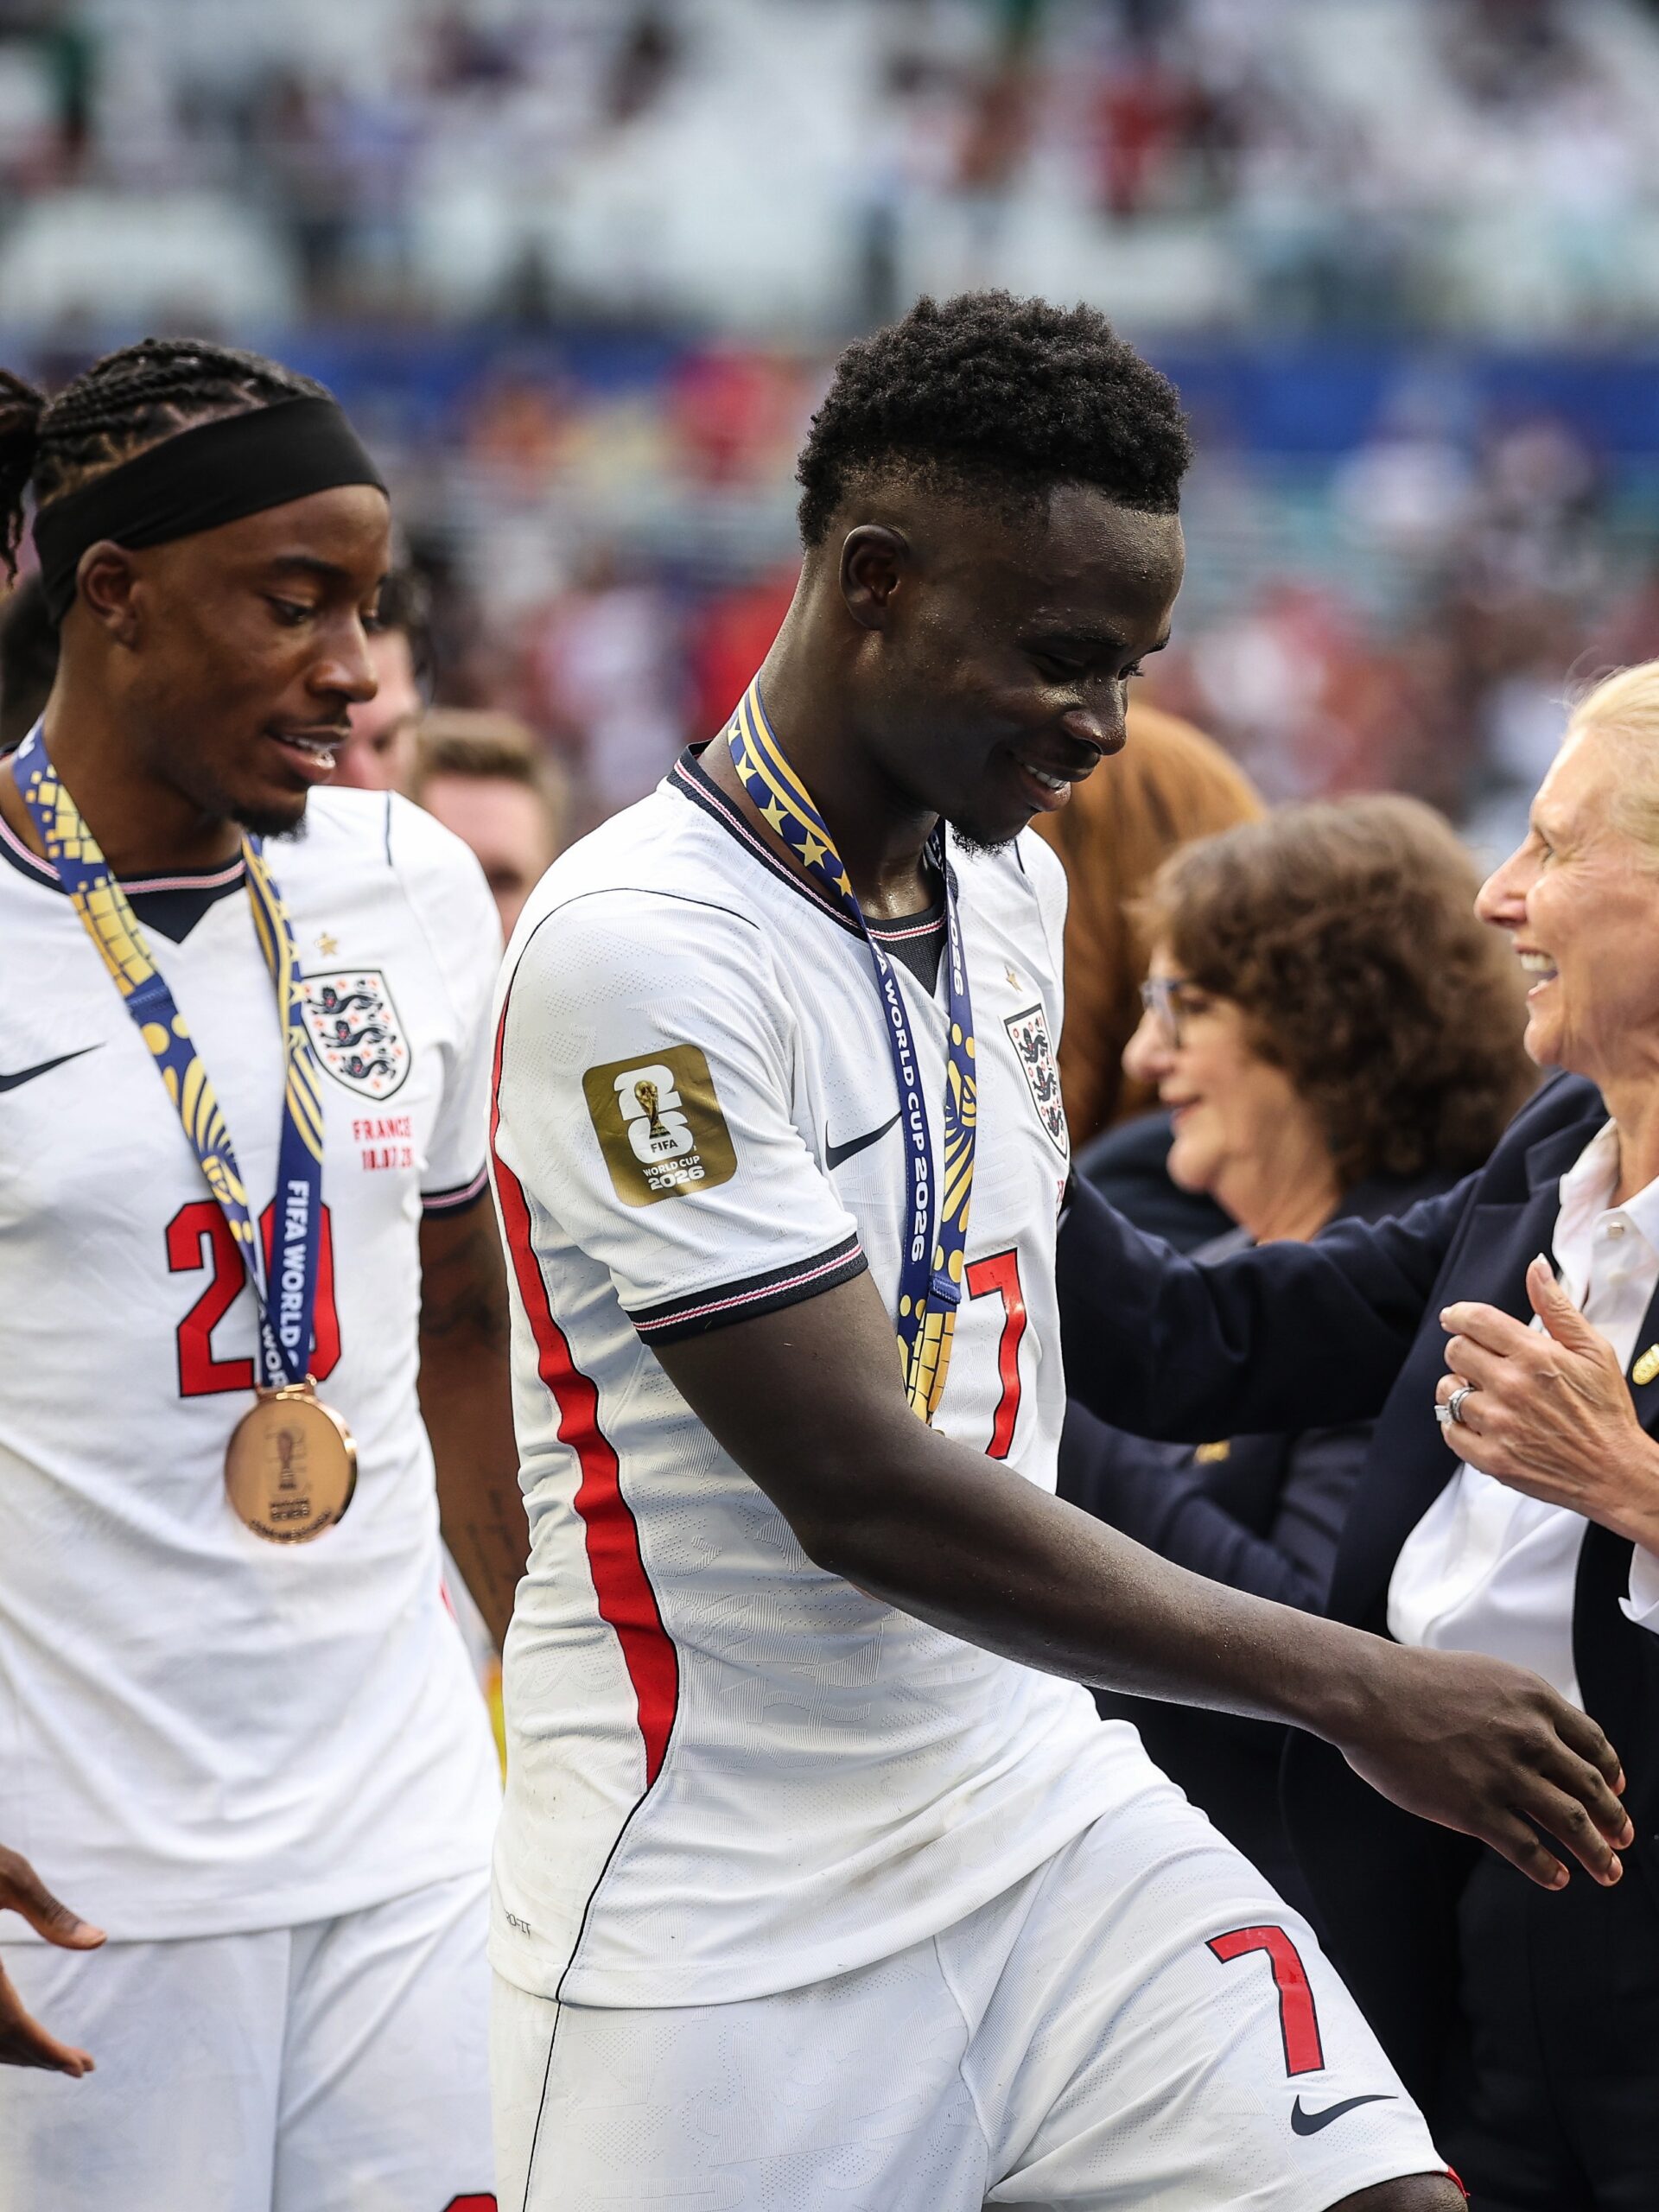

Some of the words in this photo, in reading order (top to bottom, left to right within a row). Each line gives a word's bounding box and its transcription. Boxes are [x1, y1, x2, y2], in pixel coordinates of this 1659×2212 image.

[885, 978, 915, 1086] WORLD
[352, 1116, 411, 1142] FRANCE
[651, 1139, 678, 1154] FIFA
[908, 1091, 925, 1152] CUP
[642, 1161, 678, 1177] WORLD
[679, 1155, 700, 1167] CUP
[648, 1166, 705, 1191] 2026
[284, 1180, 309, 1242] FIFA
[912, 1158, 928, 1262] 2026
[279, 1243, 306, 1348] WORLD
[964, 1247, 1027, 1460] 7
[1205, 1925, 1325, 2078] 7
